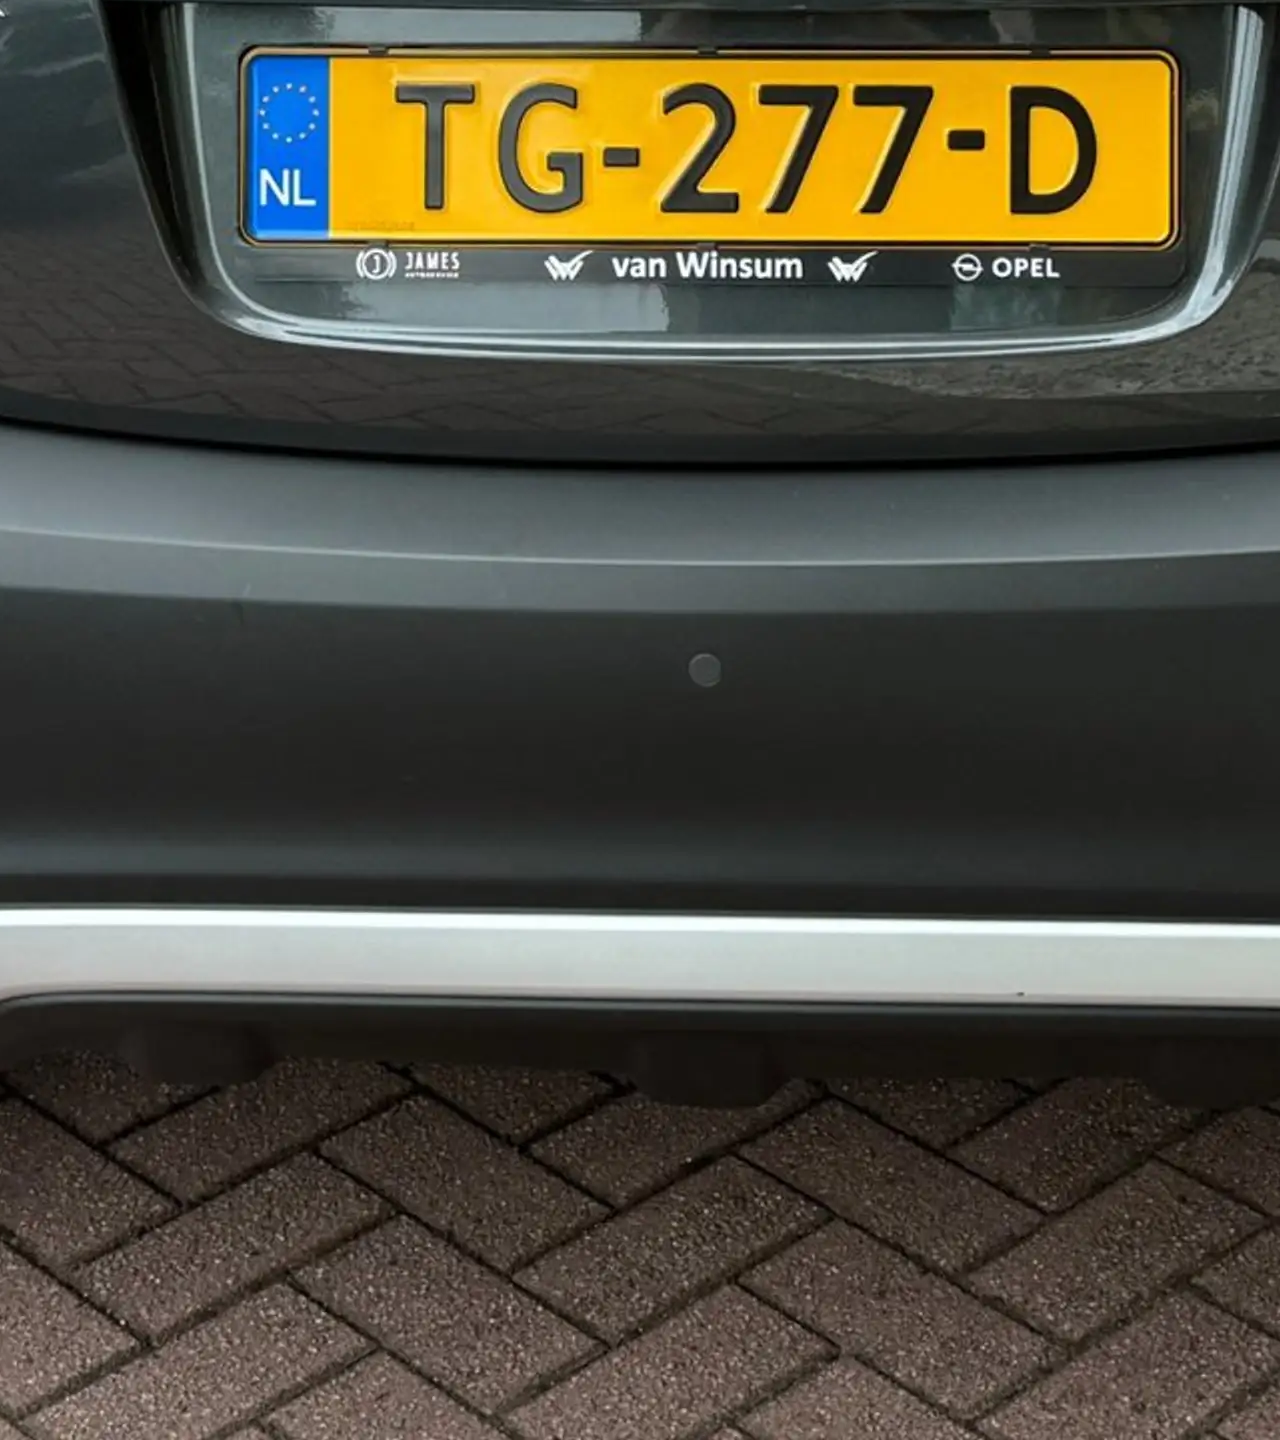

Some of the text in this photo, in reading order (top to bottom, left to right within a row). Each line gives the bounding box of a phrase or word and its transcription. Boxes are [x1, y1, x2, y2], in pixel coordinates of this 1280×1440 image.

[395, 81, 1097, 216] TG-277-D
[259, 168, 317, 206] NL
[404, 251, 460, 270] JAMES
[611, 251, 803, 279] van Winsum
[991, 257, 1061, 278] OPEL
